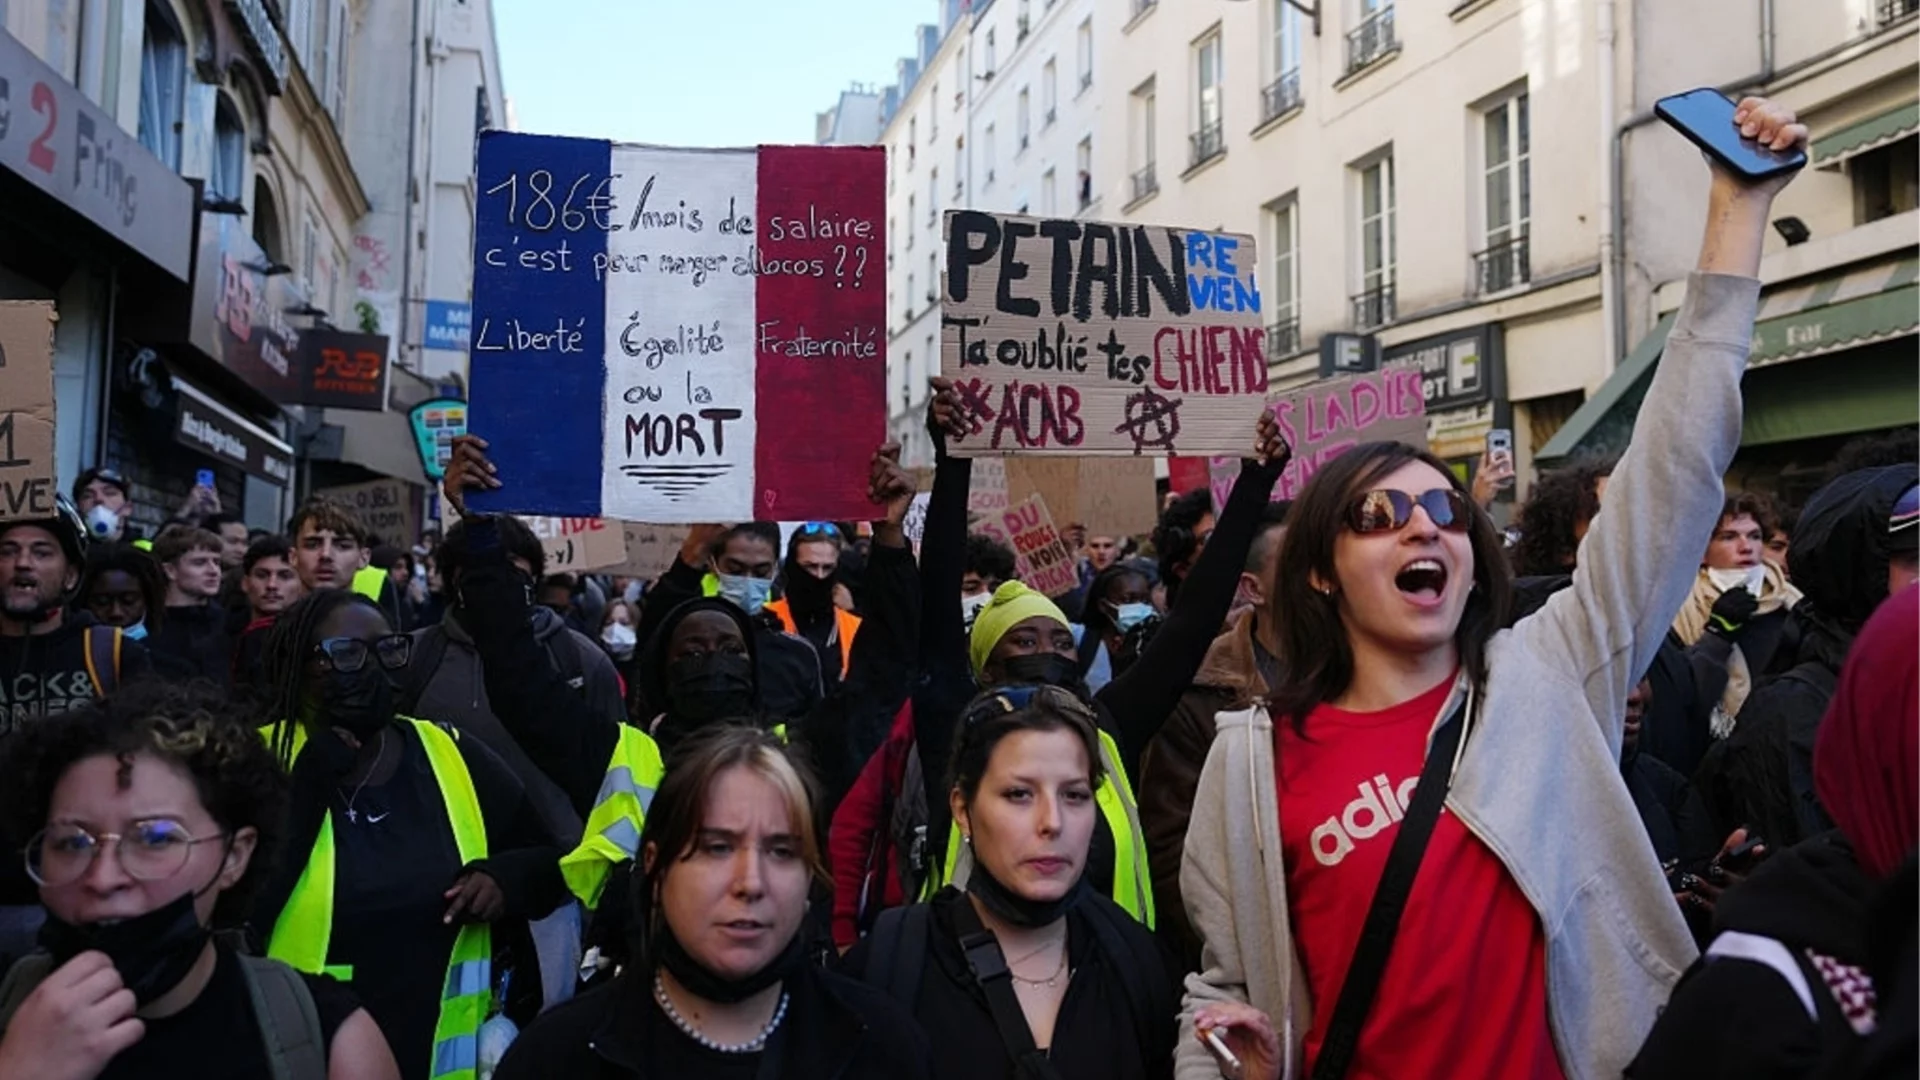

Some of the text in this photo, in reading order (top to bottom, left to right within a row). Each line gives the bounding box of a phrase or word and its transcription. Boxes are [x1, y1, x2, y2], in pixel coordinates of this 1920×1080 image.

[27, 81, 58, 174] 2
[719, 196, 754, 235] de
[486, 237, 572, 271] c'est
[593, 252, 649, 282] pour
[947, 210, 1191, 323] PETAIN
[1186, 231, 1239, 275] RE
[1186, 274, 1261, 314] VIEN
[476, 311, 877, 369] Liberté Égalité Fraternité
[996, 321, 1088, 372] oublié
[1097, 329, 1151, 384] tes
[1153, 326, 1268, 395] CHIENS
[623, 371, 713, 404] ou la
[624, 408, 742, 459] MORT
[1002, 502, 1041, 535] DU
[1310, 773, 1421, 866] adi
